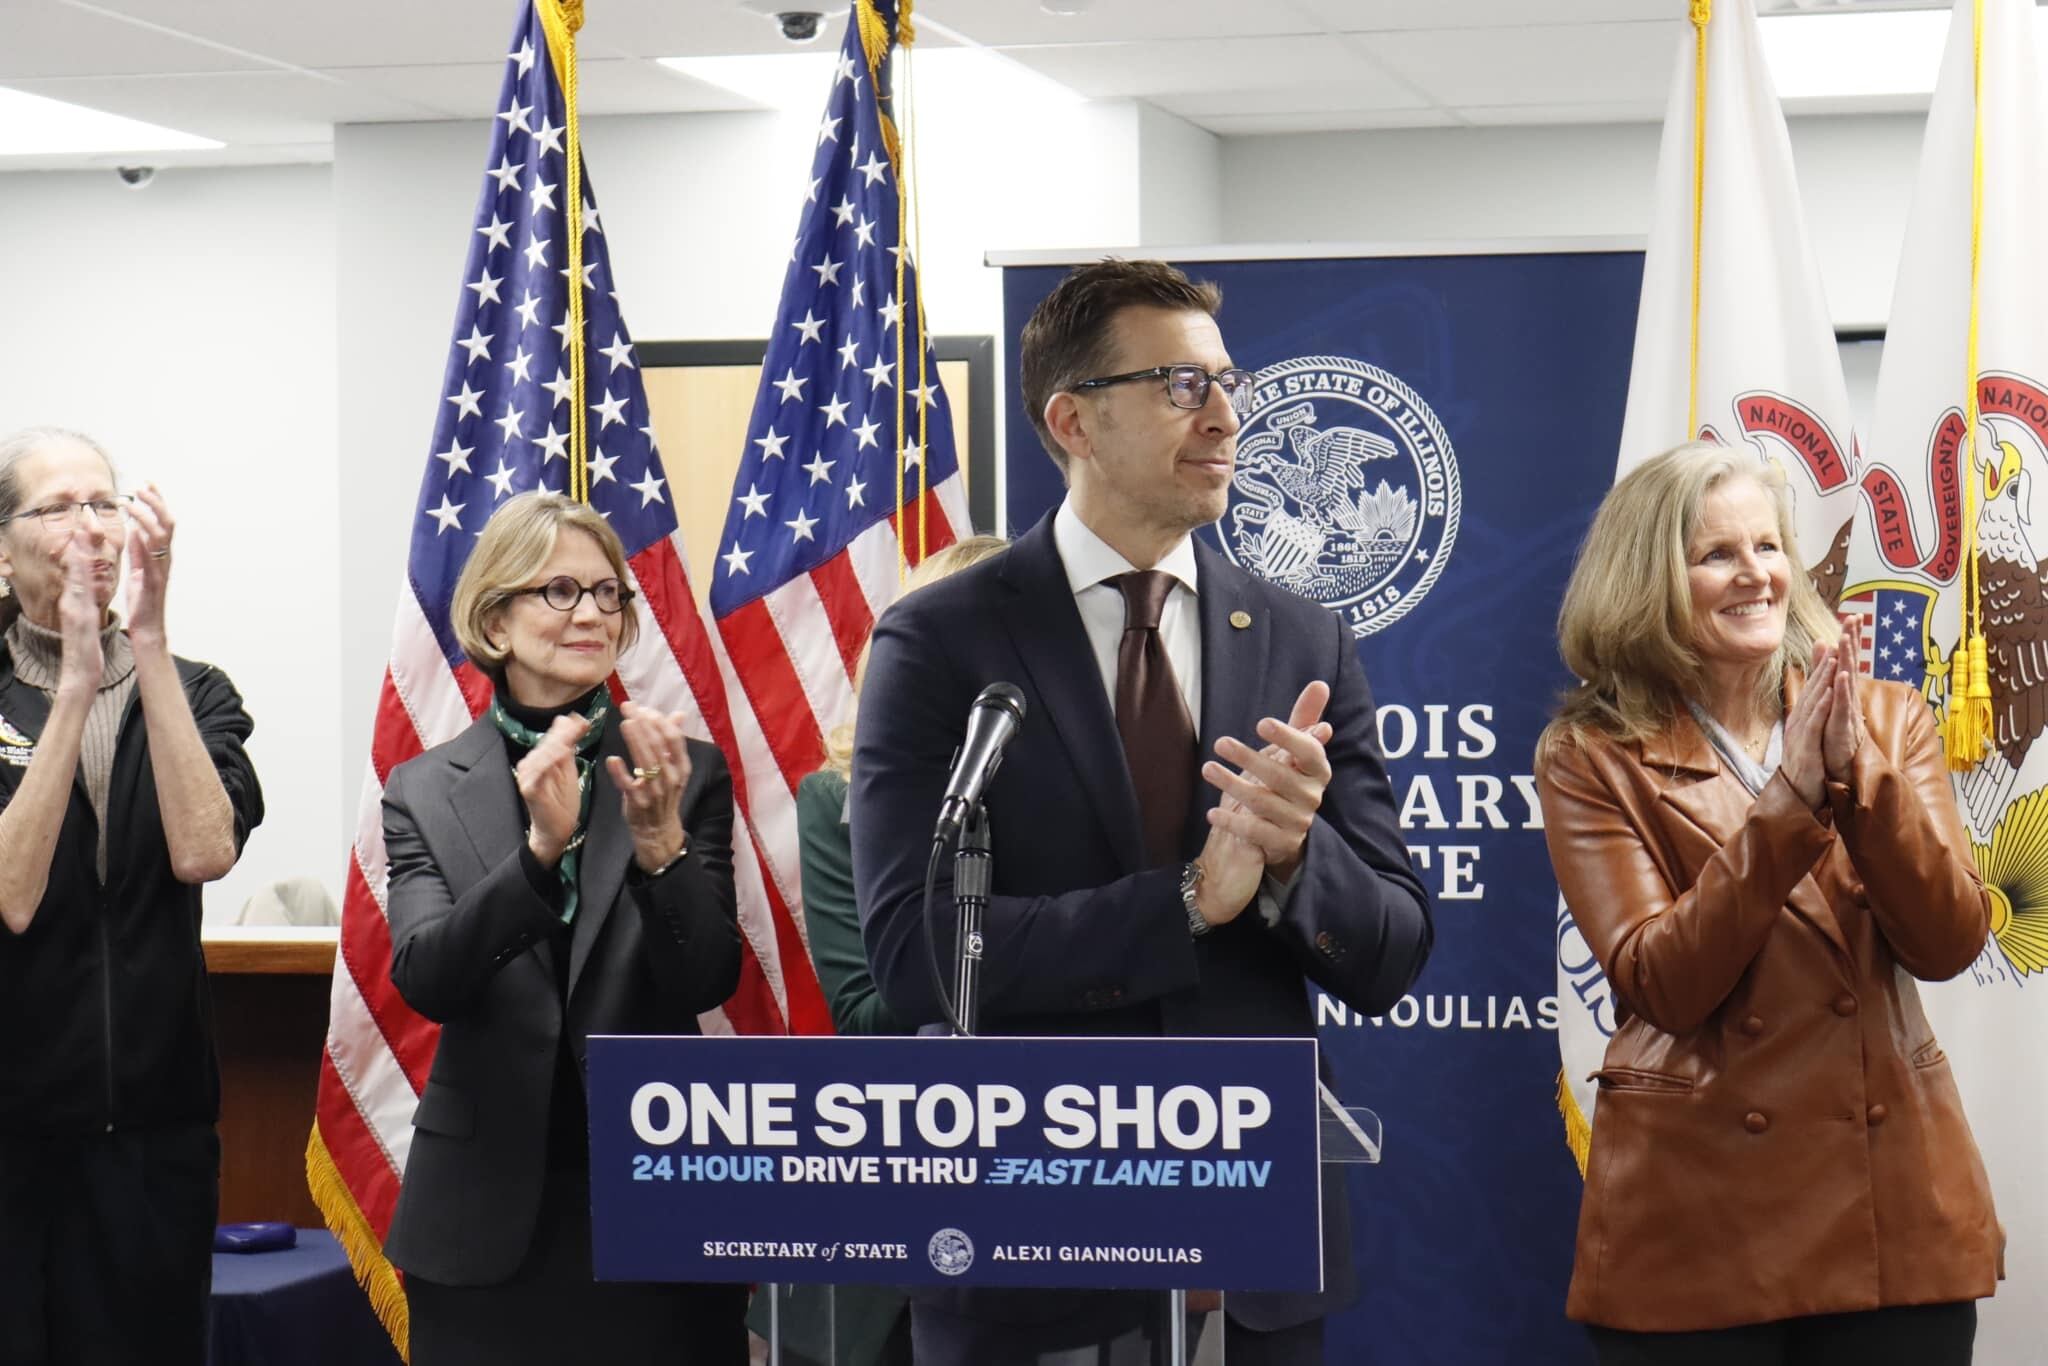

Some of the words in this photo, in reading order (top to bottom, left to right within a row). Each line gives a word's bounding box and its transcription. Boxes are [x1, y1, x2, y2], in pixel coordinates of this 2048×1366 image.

[1276, 407, 1307, 425] UNION
[1239, 437, 1277, 459] NATIONAL
[1285, 373, 1363, 394] STATE
[1367, 387, 1400, 412] OF
[1396, 408, 1446, 517] ILLINOIS
[1750, 405, 1834, 476] NATIONAL
[1241, 506, 1265, 519] STATE
[1873, 481, 1904, 551] STATE
[1937, 420, 1958, 579] SOVEREIGNTY
[1350, 585, 1401, 622] 1818
[630, 1081, 798, 1146] ONE
[814, 1083, 1027, 1149] STOP
[1042, 1085, 1272, 1150] SHOP
[632, 1154, 674, 1181] 24
[680, 1155, 775, 1181] HOUR
[781, 1156, 881, 1183] DRIVE
[886, 1157, 978, 1184] THRU
[1000, 1158, 1092, 1186] FAST
[1092, 1159, 1185, 1186] LANE
[1191, 1160, 1272, 1187] DMV
[703, 1241, 817, 1257] SECRETARY
[821, 1242, 840, 1262] of
[844, 1243, 908, 1259] STATE
[992, 1246, 1051, 1261] ALEXI
[1058, 1247, 1203, 1263] GIANNOULIAS
